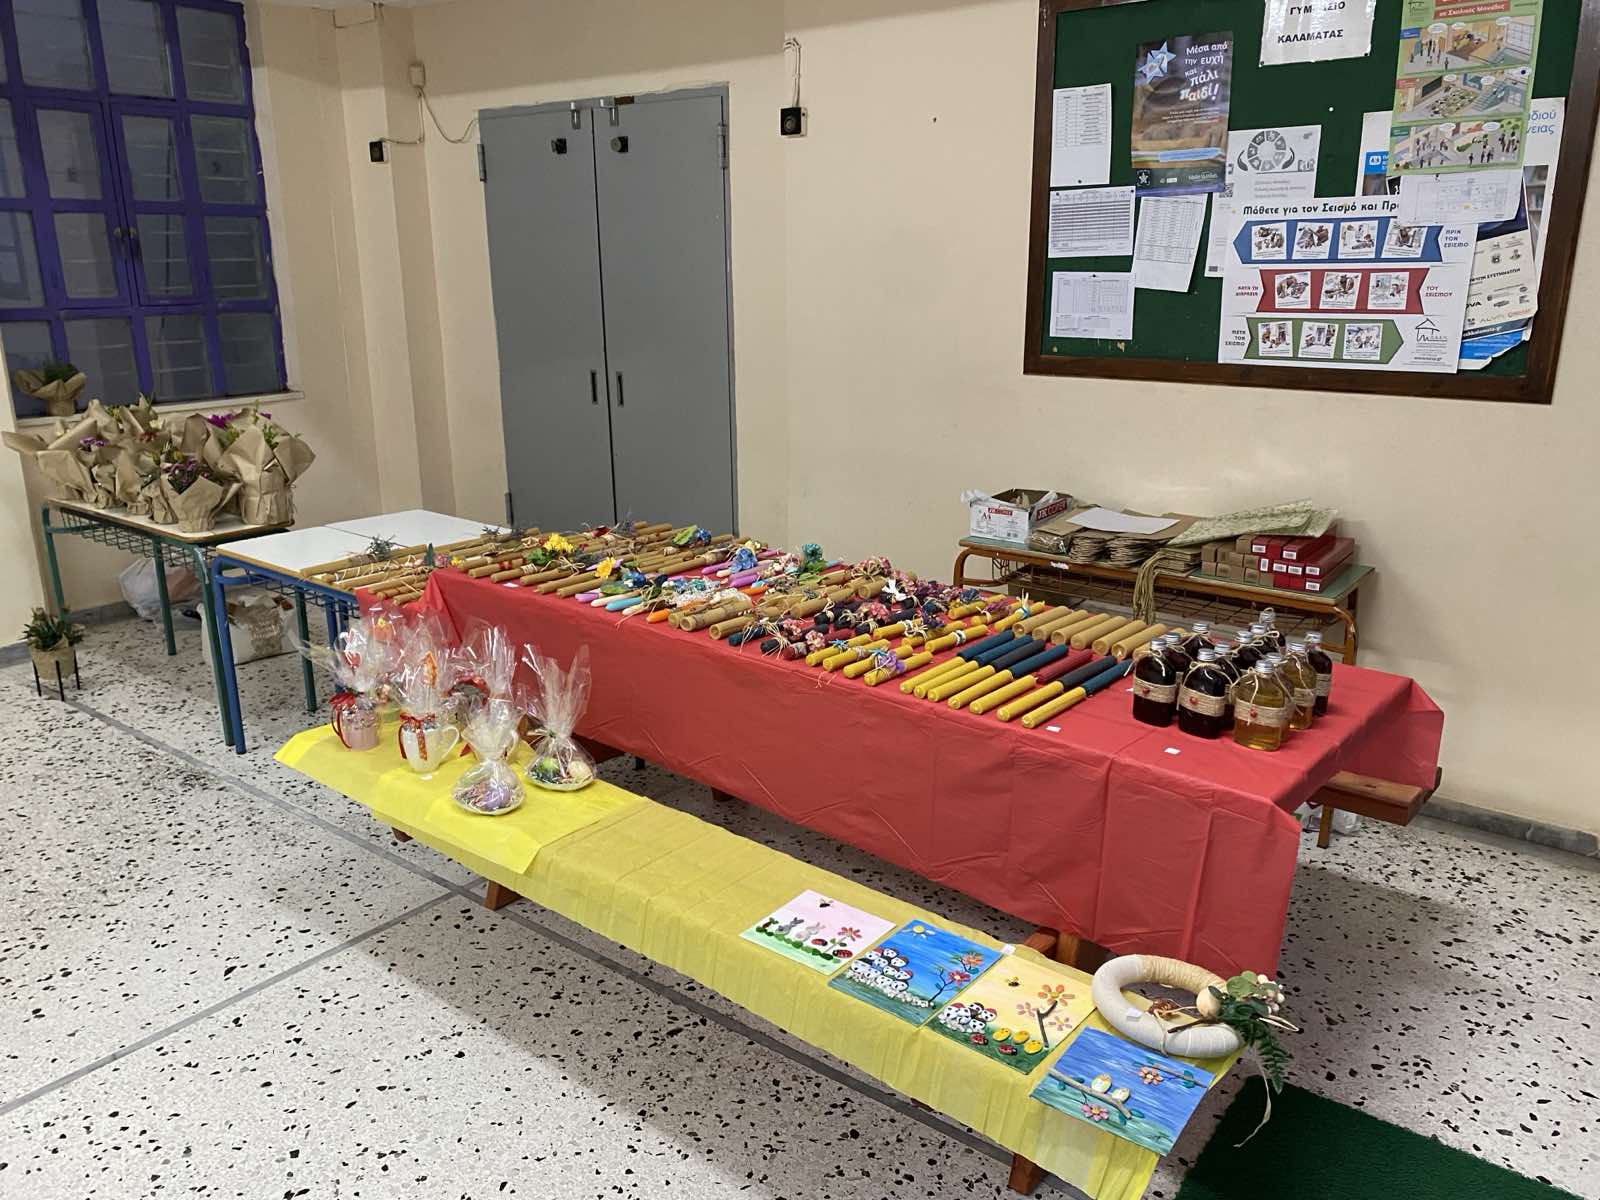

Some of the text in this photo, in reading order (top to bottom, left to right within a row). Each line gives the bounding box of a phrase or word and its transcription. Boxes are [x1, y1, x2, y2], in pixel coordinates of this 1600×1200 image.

[1290, 1, 1346, 15] ΓΥΜΣΙΟ
[1277, 29, 1344, 43] ΚΑΛΑΜΑΤΑΣ
[1186, 41, 1228, 56] Μέσα από
[1185, 52, 1224, 66] την ευχή
[1185, 67, 1198, 77] και
[1190, 69, 1219, 87] πάλι
[1180, 82, 1220, 101] παιδί!
[1243, 205, 1280, 215] Μάθετε
[1283, 206, 1298, 216] για
[1322, 202, 1357, 214] Σεισμό
[1361, 203, 1378, 211] και
